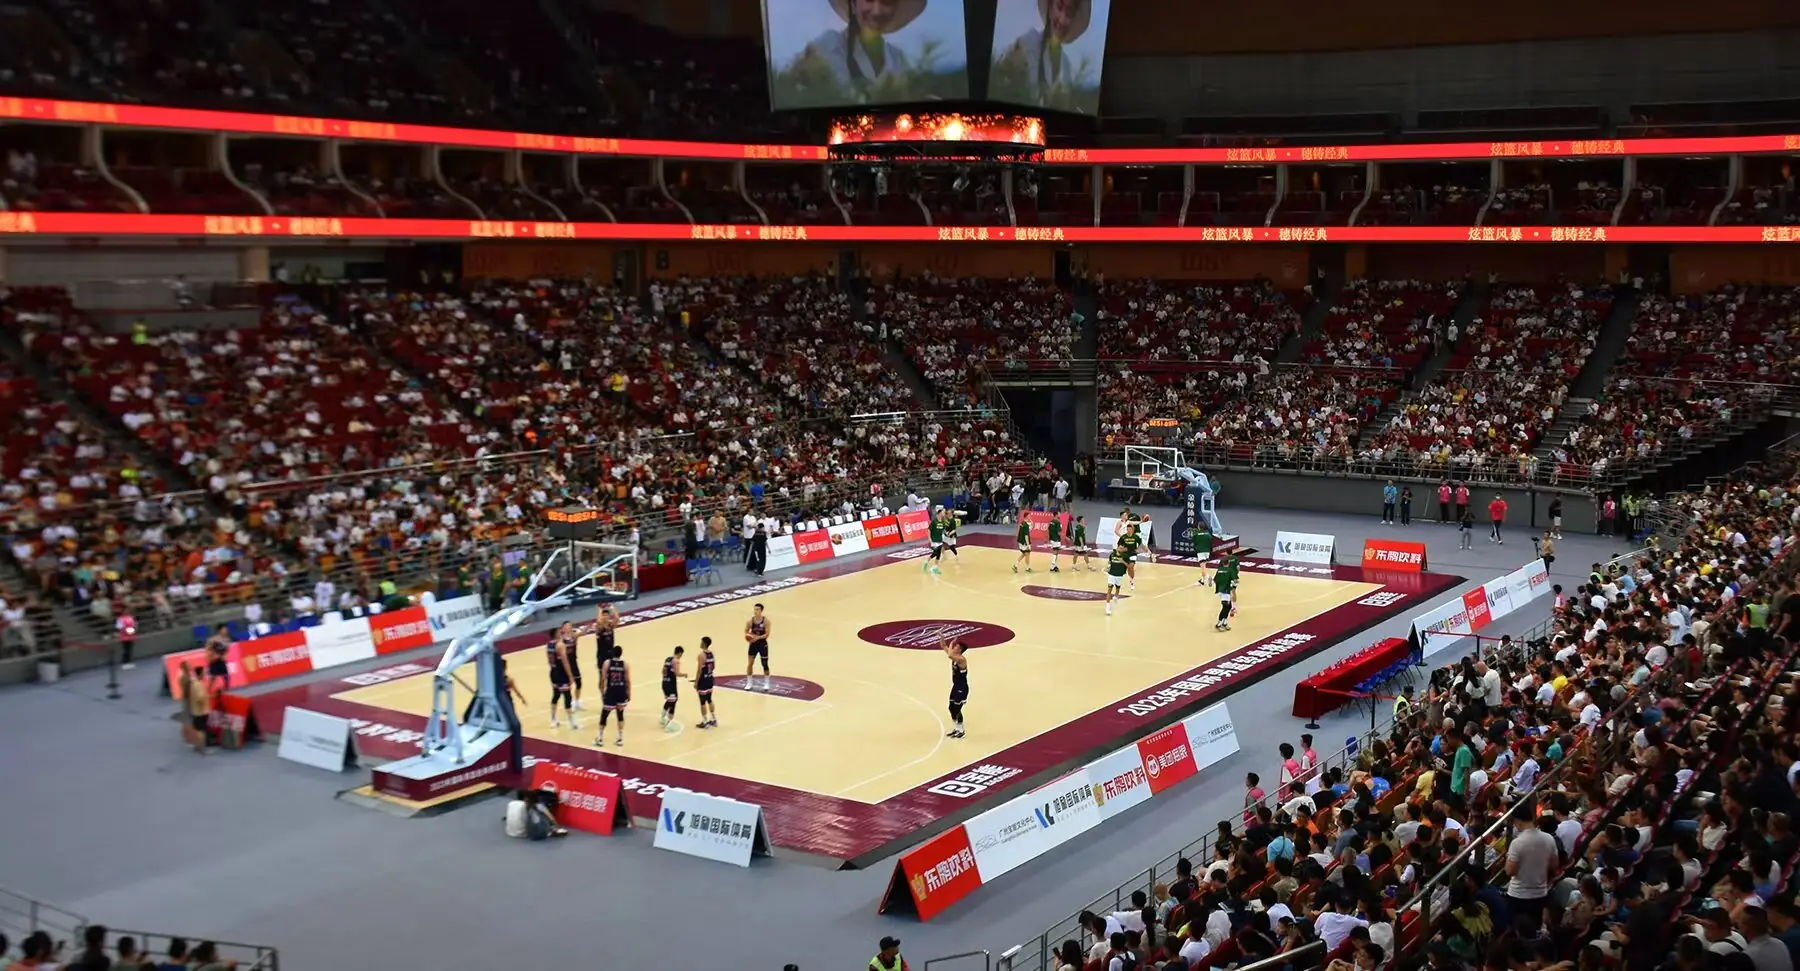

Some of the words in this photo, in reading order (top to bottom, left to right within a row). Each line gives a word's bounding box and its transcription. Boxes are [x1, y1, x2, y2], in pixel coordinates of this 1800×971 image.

[1375, 549, 1422, 565] 东鹏饮料
[1103, 766, 1147, 800] 东鹏饮料
[923, 846, 975, 893] 东鹏饮料
